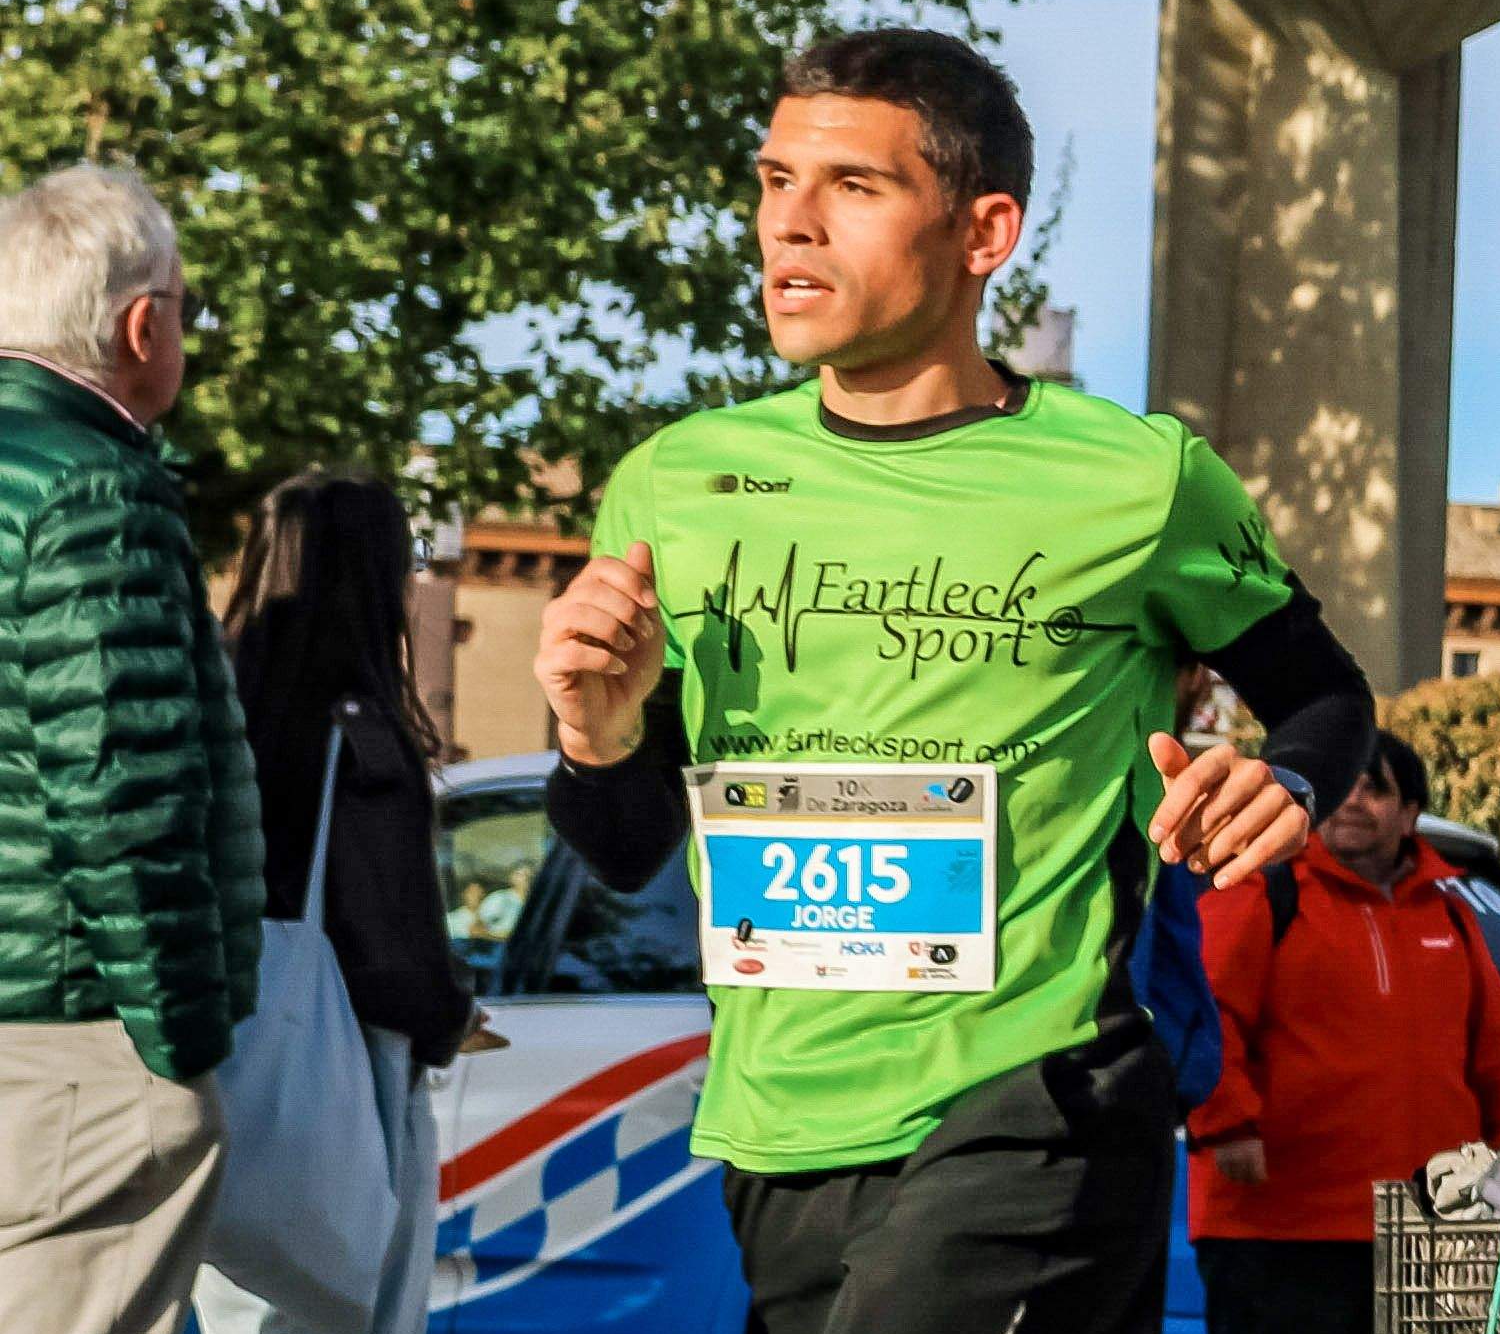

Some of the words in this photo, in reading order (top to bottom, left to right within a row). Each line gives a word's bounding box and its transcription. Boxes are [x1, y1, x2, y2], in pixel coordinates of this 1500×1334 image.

[811, 551, 1046, 618] Fartleck
[877, 613, 1034, 681] Sport
[830, 796, 908, 814] Zaragoza
[762, 842, 912, 903] 2615
[790, 904, 876, 931] JORGE
